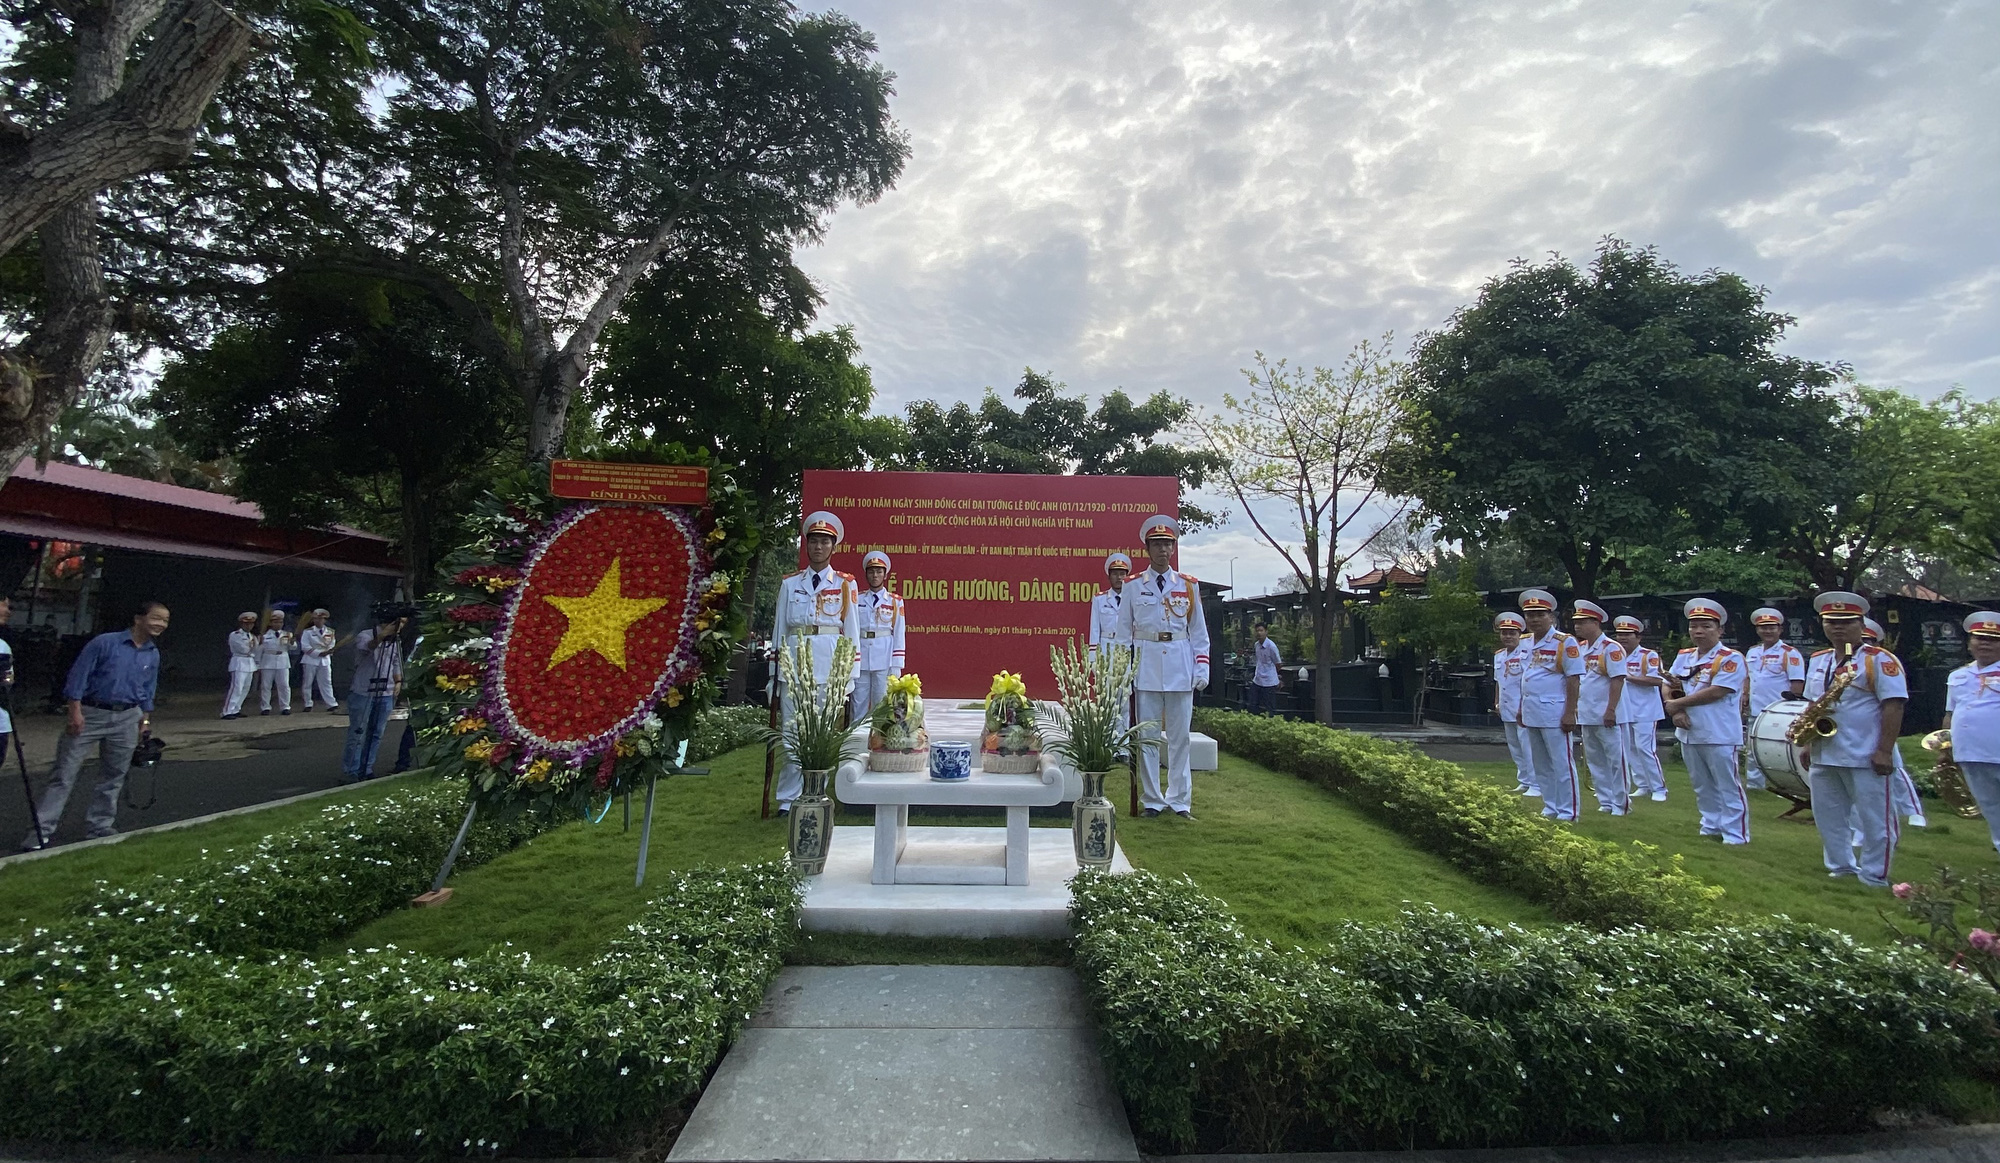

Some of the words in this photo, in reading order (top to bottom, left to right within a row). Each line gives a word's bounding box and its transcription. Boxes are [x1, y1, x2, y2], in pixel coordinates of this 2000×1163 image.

[590, 489, 624, 499] KÍNH
[627, 491, 667, 501] DÂNG
[835, 496, 855, 510] NIỆM
[857, 498, 872, 508] 100
[873, 496, 891, 508] NĂM
[892, 496, 913, 508] NGÀY
[914, 498, 933, 509] SINH
[934, 496, 956, 509] ĐỒNG
[958, 497, 971, 509] CHÍ
[972, 499, 985, 512] ĐẠI
[987, 499, 1013, 510] TƯỚNG
[1014, 499, 1023, 511] LÊ
[1024, 499, 1040, 511] ĐỨC
[1041, 501, 1058, 511] ANH
[1059, 501, 1106, 513] (01/12/1920
[1111, 502, 1158, 514] 01/12/2020)
[889, 513, 906, 525] CHỦ
[907, 515, 924, 528] TỊCH
[925, 514, 947, 526] NƯỚC
[948, 515, 969, 528] CỘNG
[970, 515, 987, 526] HÒA
[987, 515, 998, 527] XÃ
[999, 515, 1013, 529] HỘI
[1014, 516, 1030, 528] CHỦ
[1031, 516, 1056, 528] NGHĨA
[1057, 517, 1074, 530] VIỆT
[1075, 518, 1094, 529] NAM
[856, 543, 867, 555] HỘI
[921, 542, 930, 554] ỦY
[931, 544, 943, 555] BAN
[980, 543, 989, 555] ỦY
[989, 545, 1002, 555] BAN
[1017, 545, 1033, 558] TRẬN
[1042, 544, 1059, 557] QUỐC
[1059, 545, 1072, 559] VIỆT
[1073, 547, 1087, 557] NAM
[1088, 546, 1107, 558] THÀNH
[1131, 545, 1142, 558] CHÍ
[887, 572, 897, 593] Ễ
[902, 576, 948, 600] DÂNG
[953, 578, 1014, 604] HƯƠNG,
[1019, 577, 1065, 603] DÂNG
[1069, 582, 1100, 603] HOA
[926, 624, 940, 635] phố
[940, 624, 950, 633] Hồ
[951, 624, 962, 634] Chí
[963, 625, 983, 635] Minh,
[984, 626, 1001, 636] ngày
[1002, 626, 1010, 634] 01
[1012, 626, 1032, 636] tháng
[1033, 627, 1042, 635] 12
[1043, 626, 1058, 635] năm
[1059, 627, 1076, 636] 2020
